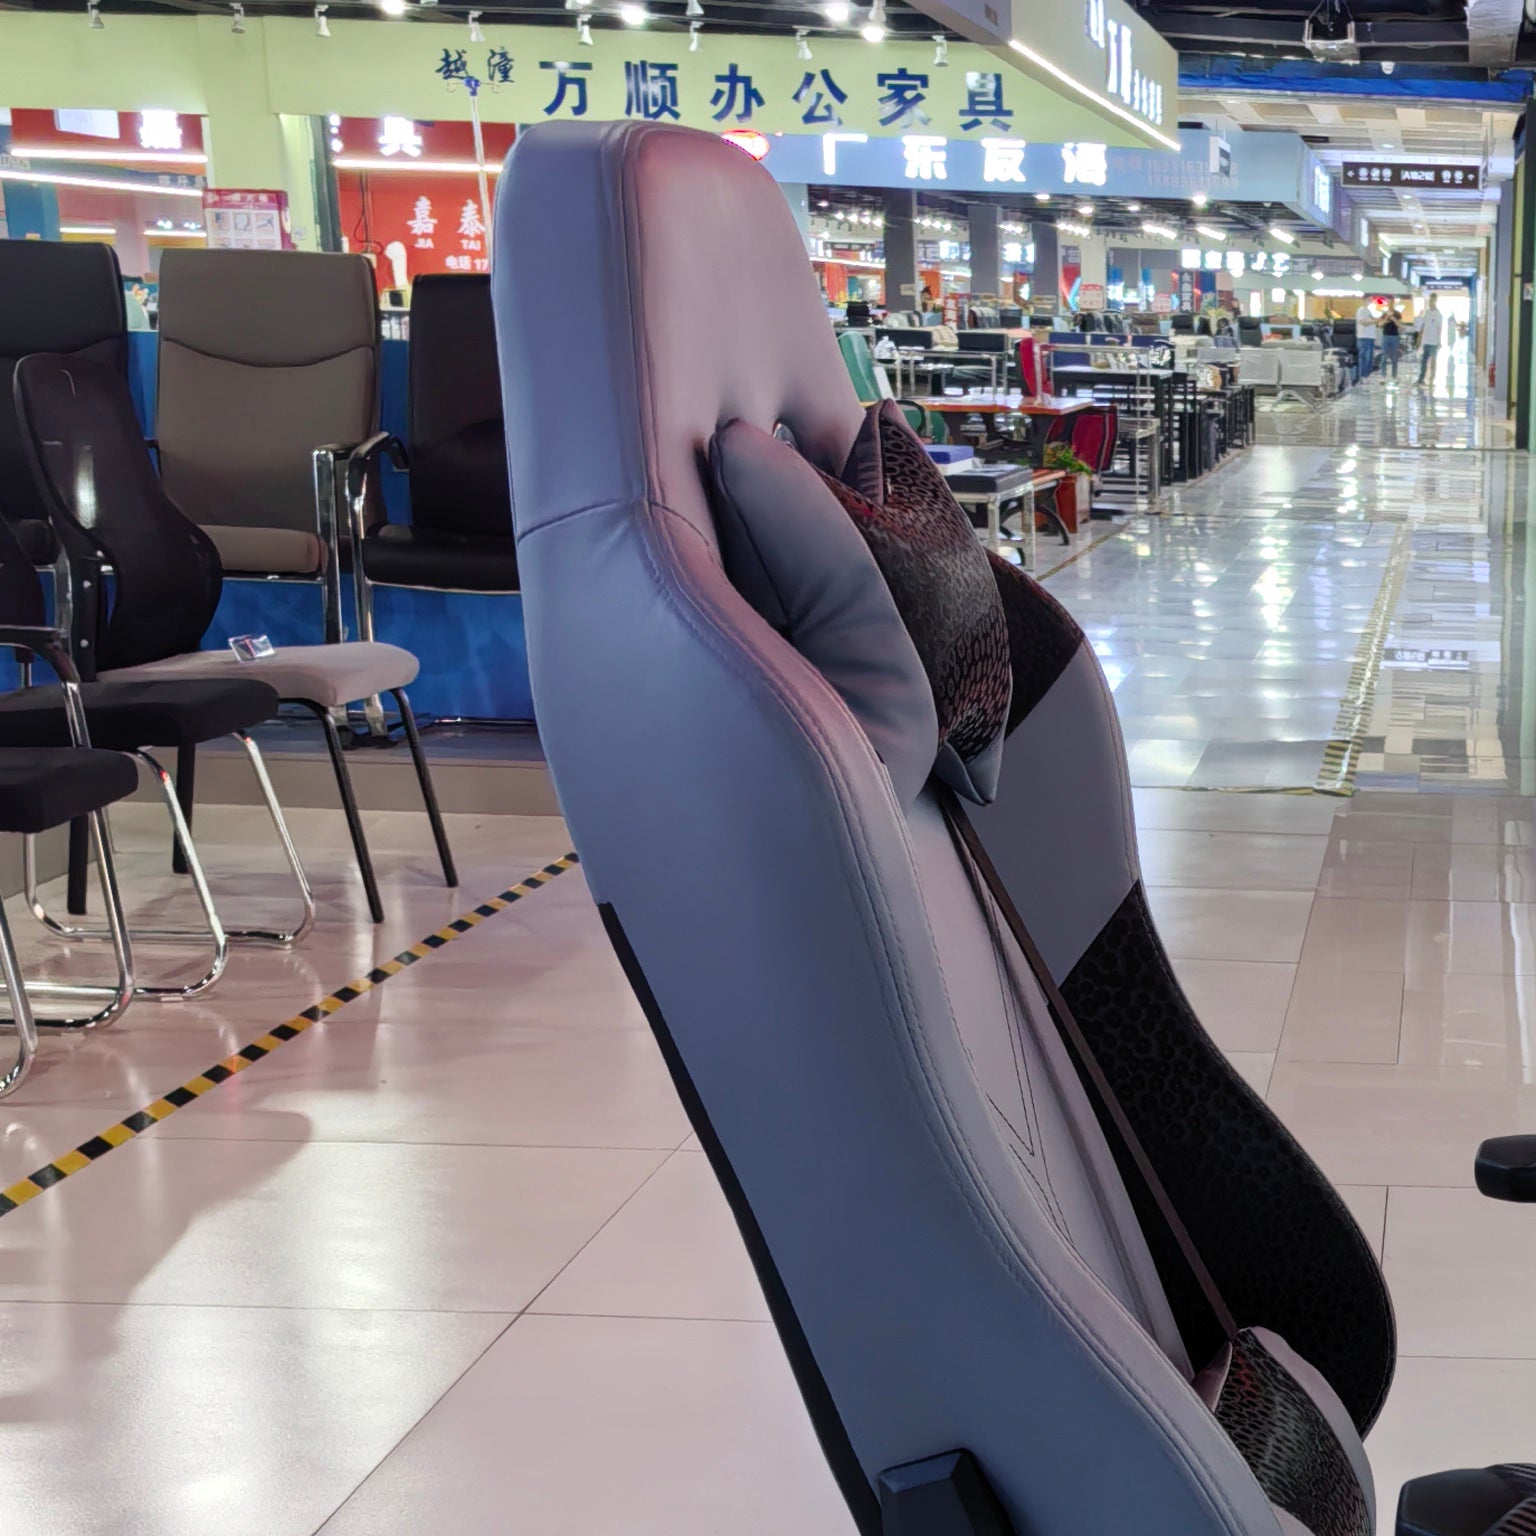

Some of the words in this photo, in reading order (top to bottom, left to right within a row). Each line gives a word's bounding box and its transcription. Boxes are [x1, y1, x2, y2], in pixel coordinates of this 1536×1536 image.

[539, 60, 1014, 133] 万顺办公家具
[406, 195, 487, 238] 嘉泰
